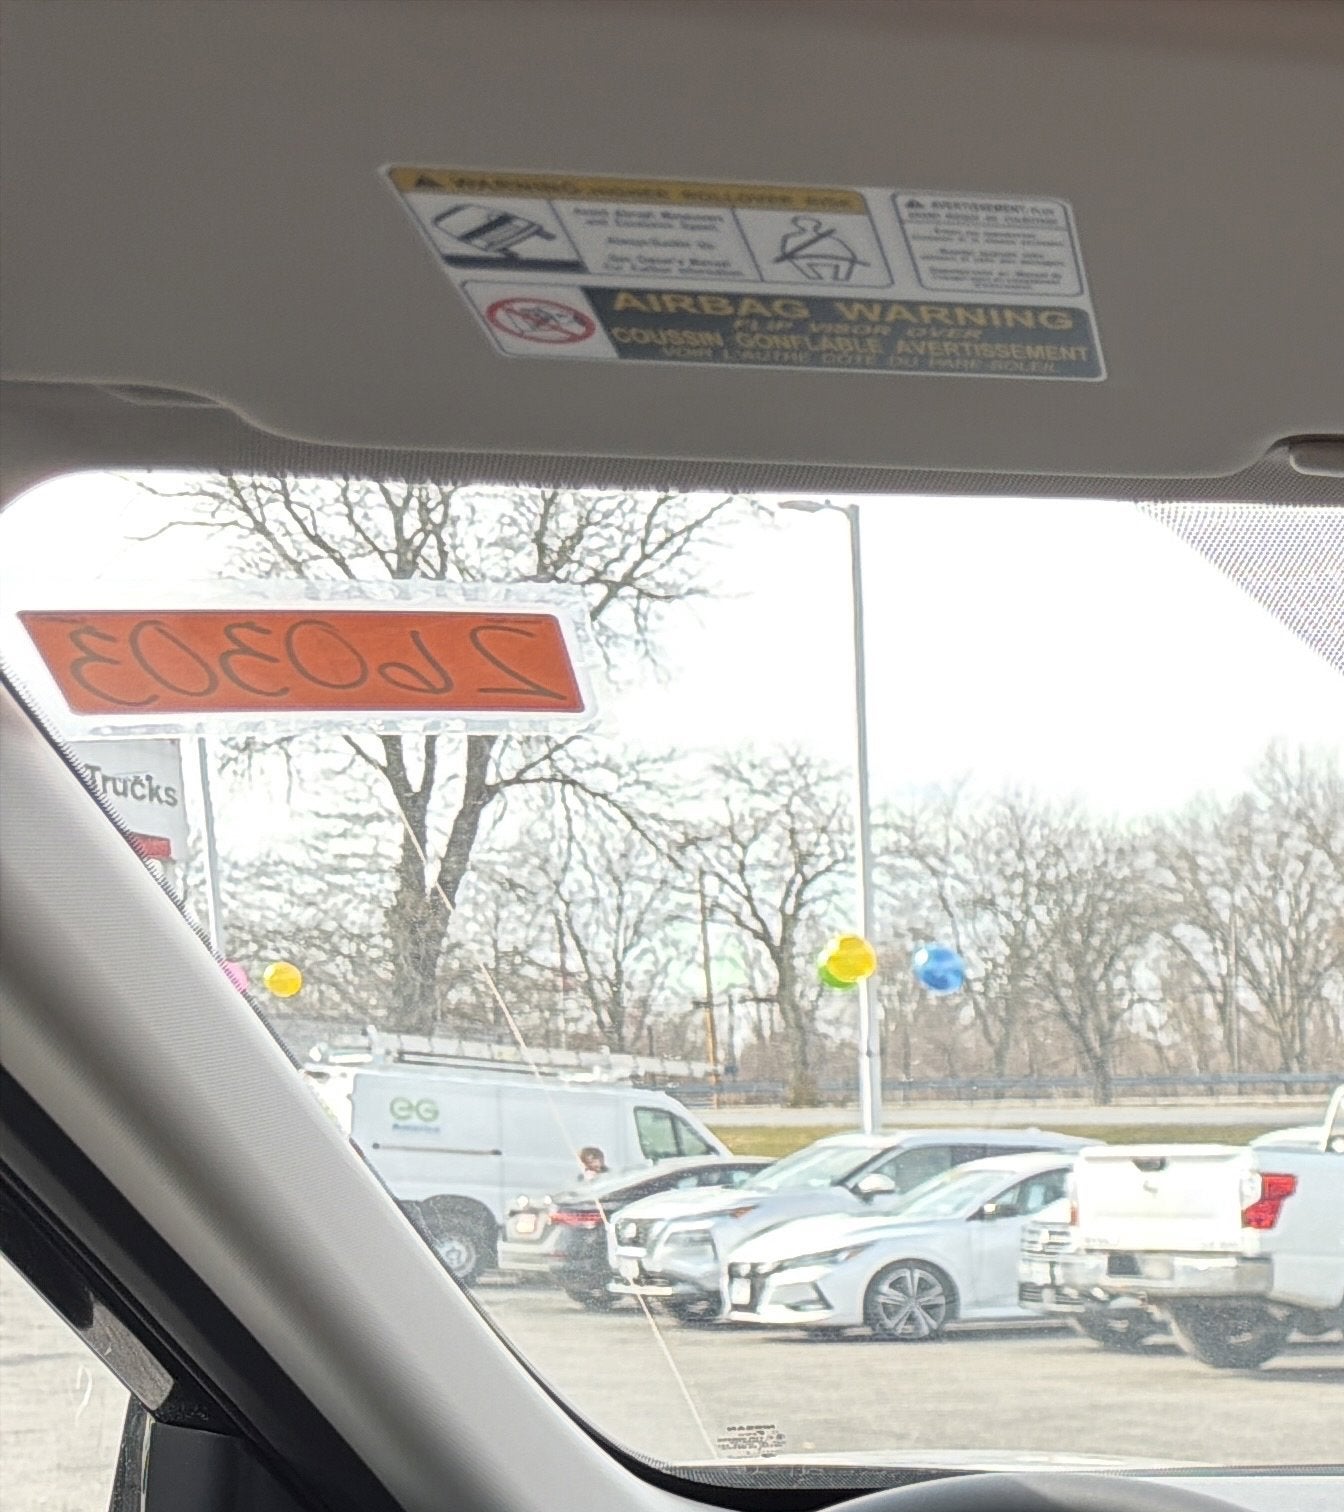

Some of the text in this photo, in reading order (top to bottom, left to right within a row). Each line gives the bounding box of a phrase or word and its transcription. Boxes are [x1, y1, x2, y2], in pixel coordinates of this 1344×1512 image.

[614, 291, 1074, 331] AIRBAG WARNING
[611, 326, 725, 347] COUSSIN
[896, 338, 1089, 362] AVERTISSEMENT
